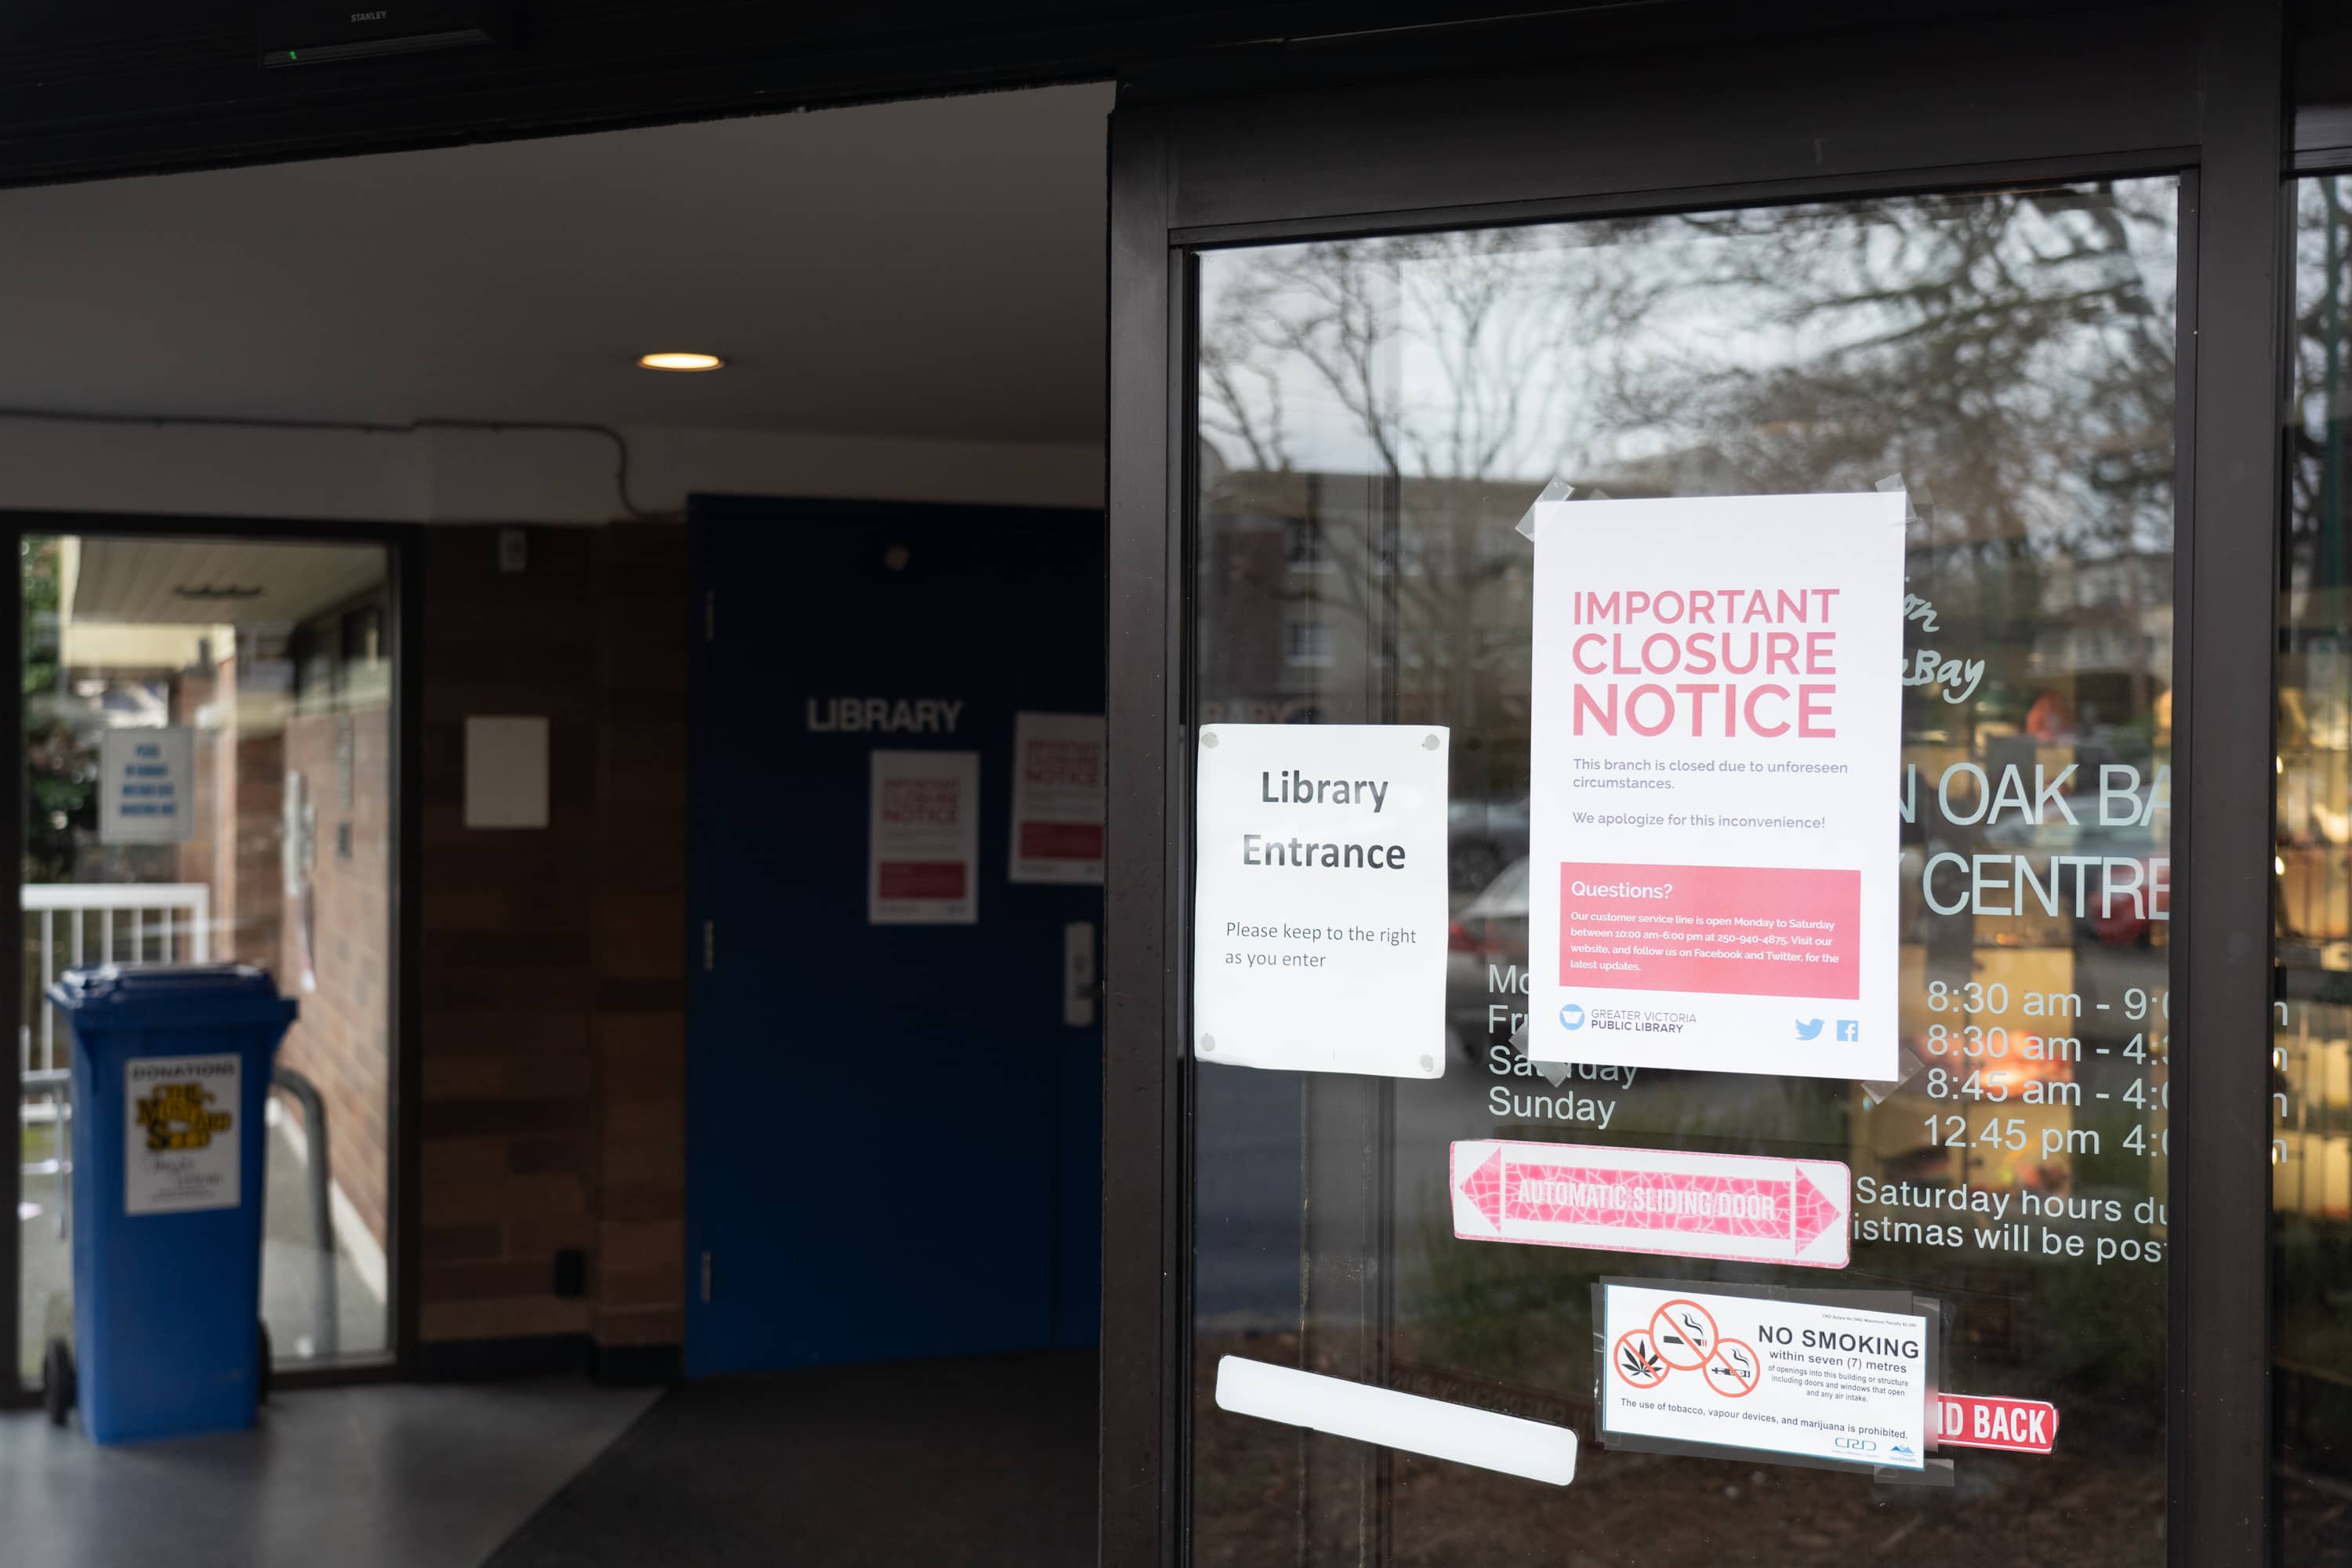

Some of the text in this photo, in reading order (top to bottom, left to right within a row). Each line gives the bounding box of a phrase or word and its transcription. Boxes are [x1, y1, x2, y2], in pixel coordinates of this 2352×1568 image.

[350, 9, 387, 23] STANLEY
[1573, 589, 1840, 625] IMPORTANT
[1573, 631, 1836, 675] CLOSURE
[808, 698, 962, 732] LIBRARY
[1573, 684, 1836, 738] NOTICE
[1573, 758, 1848, 774] This branch is closed due to unforeseen
[1573, 776, 1675, 789] circumstances.
[1261, 770, 1388, 813] Library
[1938, 762, 2079, 826] OAK
[1573, 811, 1825, 829] We apologize for this inconvenience!
[1243, 833, 1406, 869] Entrance
[1571, 880, 1673, 899] Questions?
[1922, 852, 2170, 920] CENTRE
[1226, 921, 1417, 946] Please keep to the right
[1570, 911, 1835, 931] Our customer service line is open Monday to Saturday
[1570, 927, 1833, 946] between 10:00 am-6:00 pm at 250-940-4875. Visit our
[1225, 951, 1327, 968] as you enter
[1570, 960, 1641, 971] latest updates.
[1612, 946, 1631, 955] and
[1633, 946, 1664, 956] follow
[1665, 948, 1677, 956] us
[1694, 948, 1742, 959] Facebook
[1744, 951, 1764, 960] and
[1766, 951, 1803, 962] Twitter,
[1806, 952, 1820, 962] for
[1822, 953, 1839, 963] the
[1592, 1008, 1697, 1023] GREATER VICTORIA
[1927, 980, 2009, 1014] 8:30
[2023, 993, 2082, 1018] am
[1592, 1020, 1683, 1033] PUBLIC LIBRARY
[1927, 1024, 2009, 1058] 8:30
[2023, 1036, 2082, 1062] am
[132, 1062, 236, 1079] DONATIONS
[1926, 1068, 2009, 1103] 8:45
[2023, 1080, 2082, 1106] am
[1488, 1086, 1617, 1130] Sunday
[1924, 1116, 2027, 1149] 12.45
[2042, 1127, 2100, 1160] pm
[1518, 1178, 1776, 1221] AUTOMATIC SLIDING DOOR
[1856, 1176, 2010, 1221] Saturday
[2022, 1190, 2122, 1222] hours
[1853, 1212, 2168, 1265] istmas will be pos
[1759, 1325, 1919, 1359] NO SMOKING
[1769, 1349, 1907, 1374] within seven (7) metres
[1777, 1366, 1808, 1377] openings
[1809, 1368, 1822, 1377] into
[1824, 1370, 1837, 1379] this
[1838, 1371, 1866, 1384] building
[1878, 1377, 1909, 1387] structure
[1771, 1375, 1905, 1398] including doors and windows that open
[1806, 1388, 1819, 1397] and
[1820, 1392, 1833, 1400] any
[1846, 1393, 1868, 1403] intake.
[1621, 1398, 1908, 1439] The use of tobacco, vapour devices, and marijuana is prohibited.
[1974, 1405, 2047, 1444] BACK
